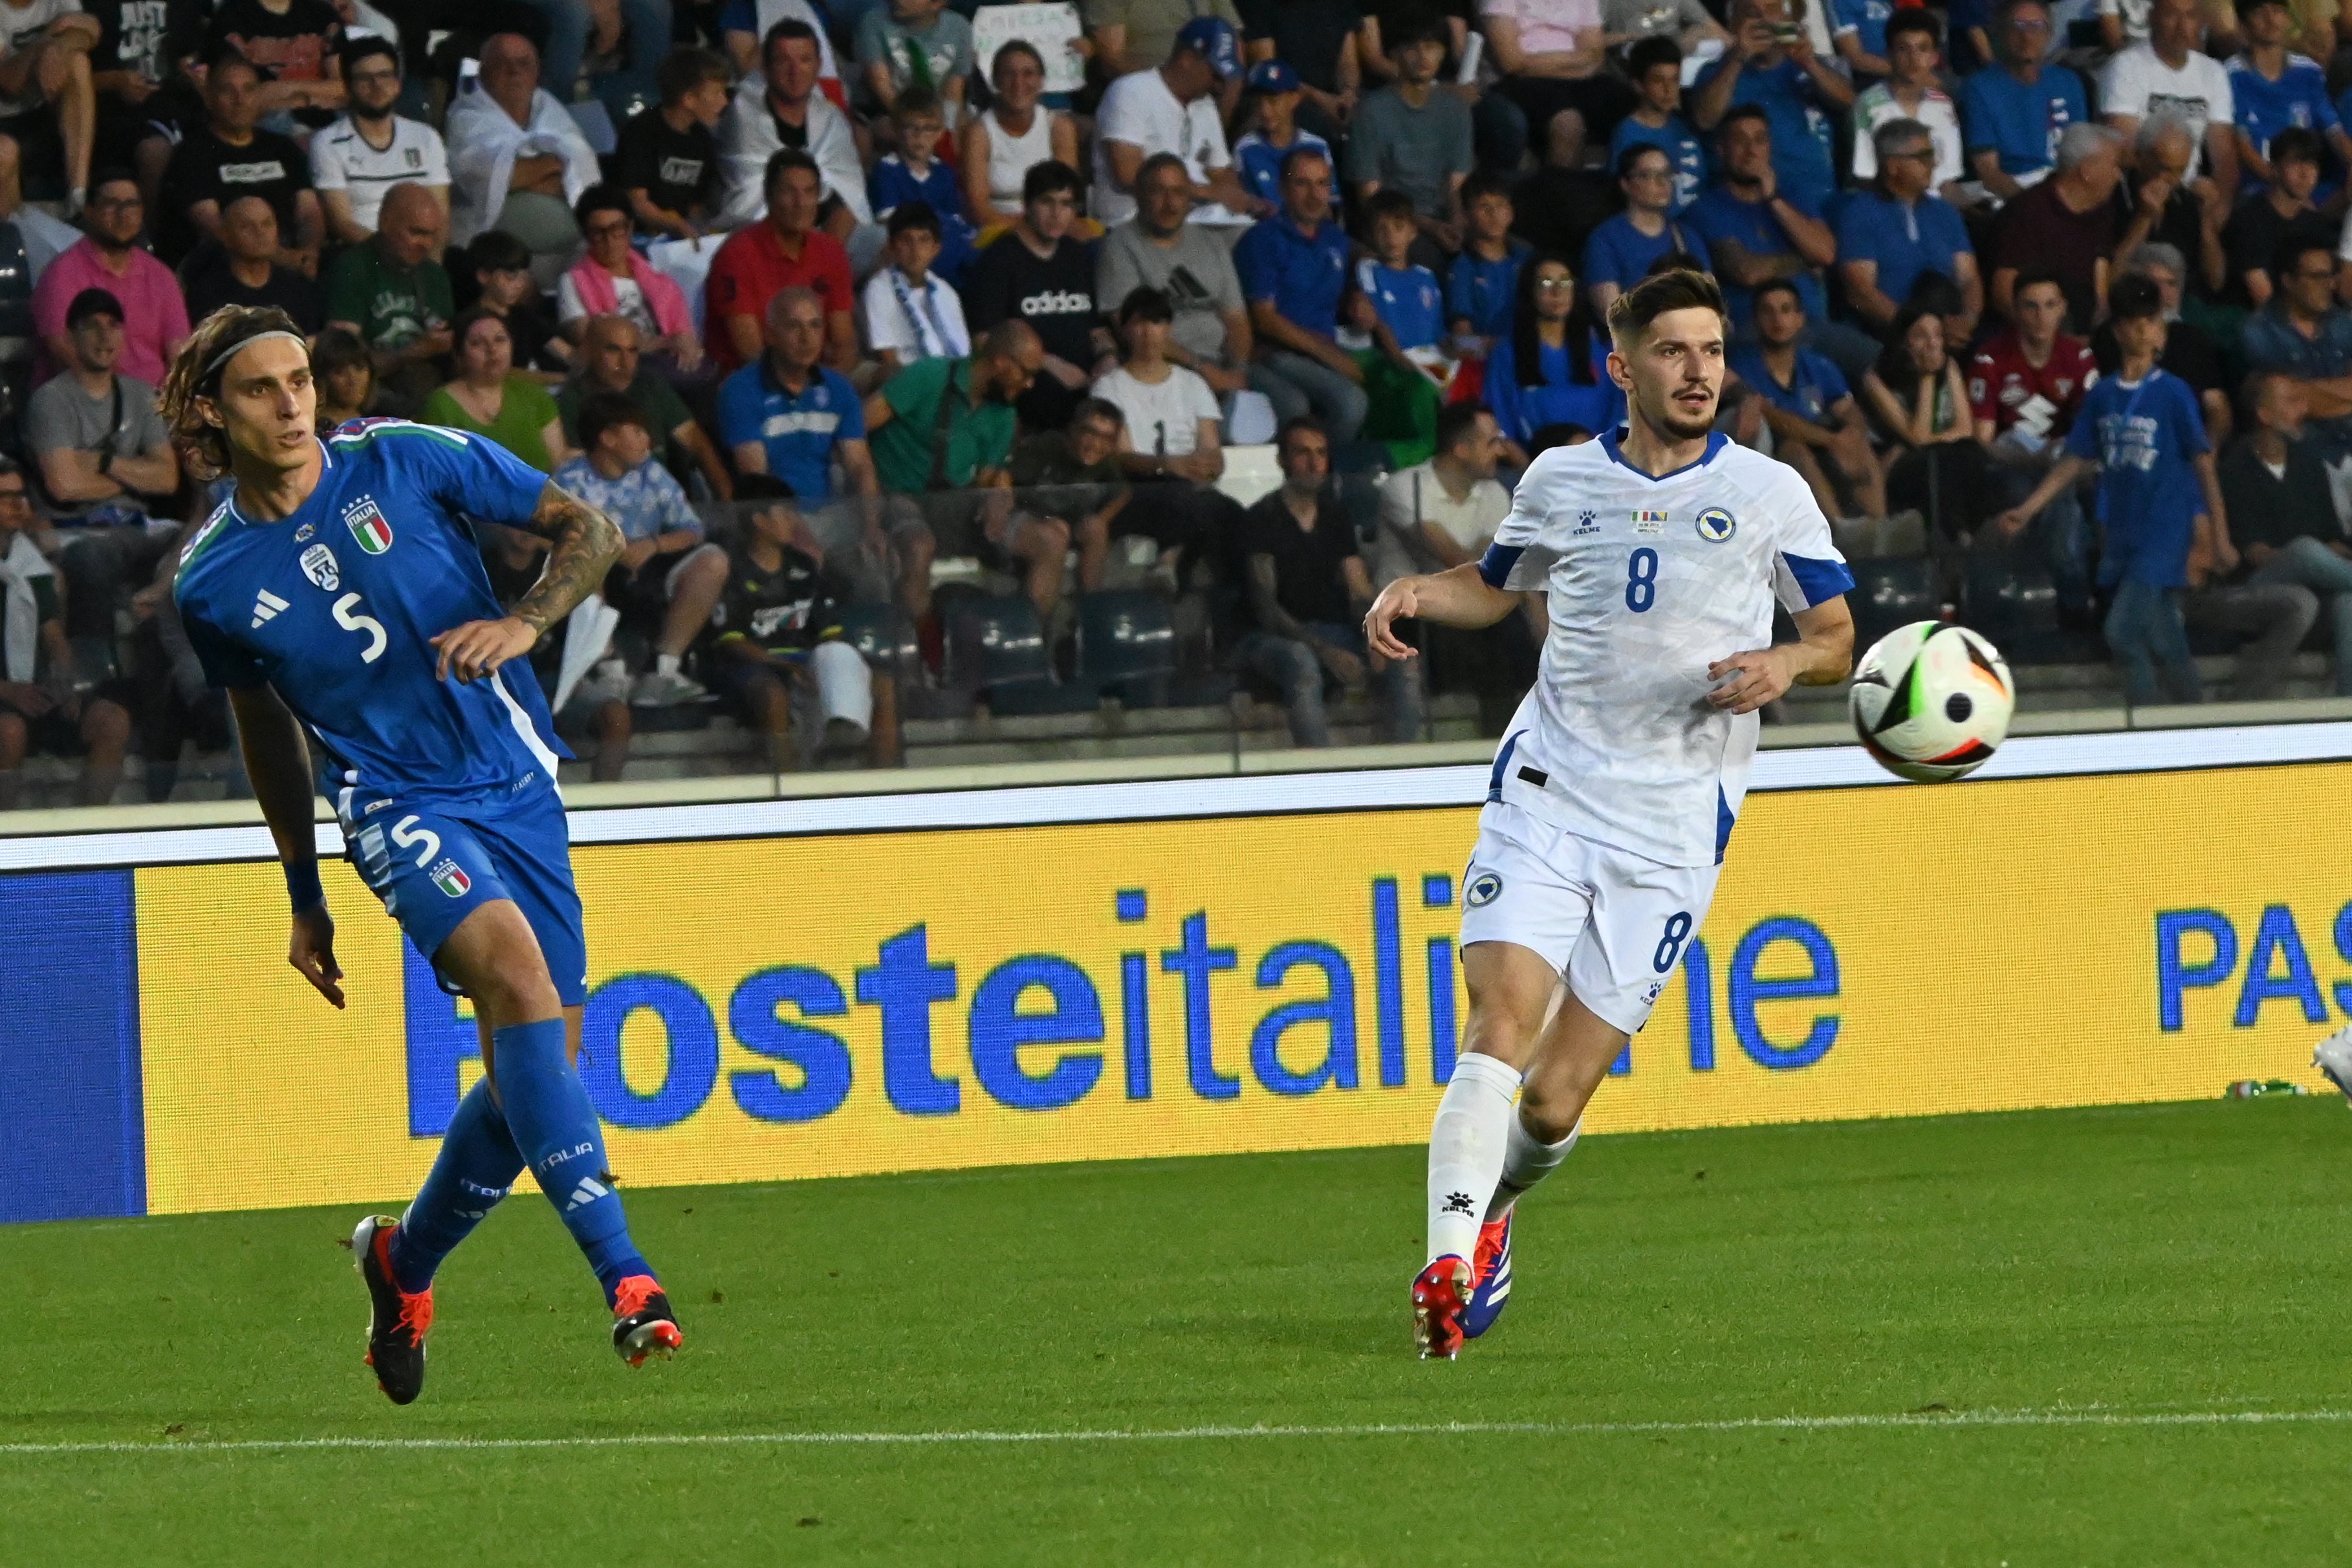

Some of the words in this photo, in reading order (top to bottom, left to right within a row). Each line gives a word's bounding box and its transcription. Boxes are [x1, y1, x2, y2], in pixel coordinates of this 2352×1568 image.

[1021, 290, 1092, 316] adidas
[349, 505, 376, 527] ITALIA
[1573, 526, 1601, 536] KELME
[1625, 547, 1659, 613] 8
[331, 592, 387, 664] 5
[391, 814, 441, 869] 5
[435, 864, 457, 883] ITALIA
[1653, 911, 1693, 974] 8
[2156, 899, 2352, 1032] PA
[402, 875, 1840, 1137] osteitalie
[460, 1179, 514, 1199] ITALI
[1442, 1206, 1475, 1219] KELME
